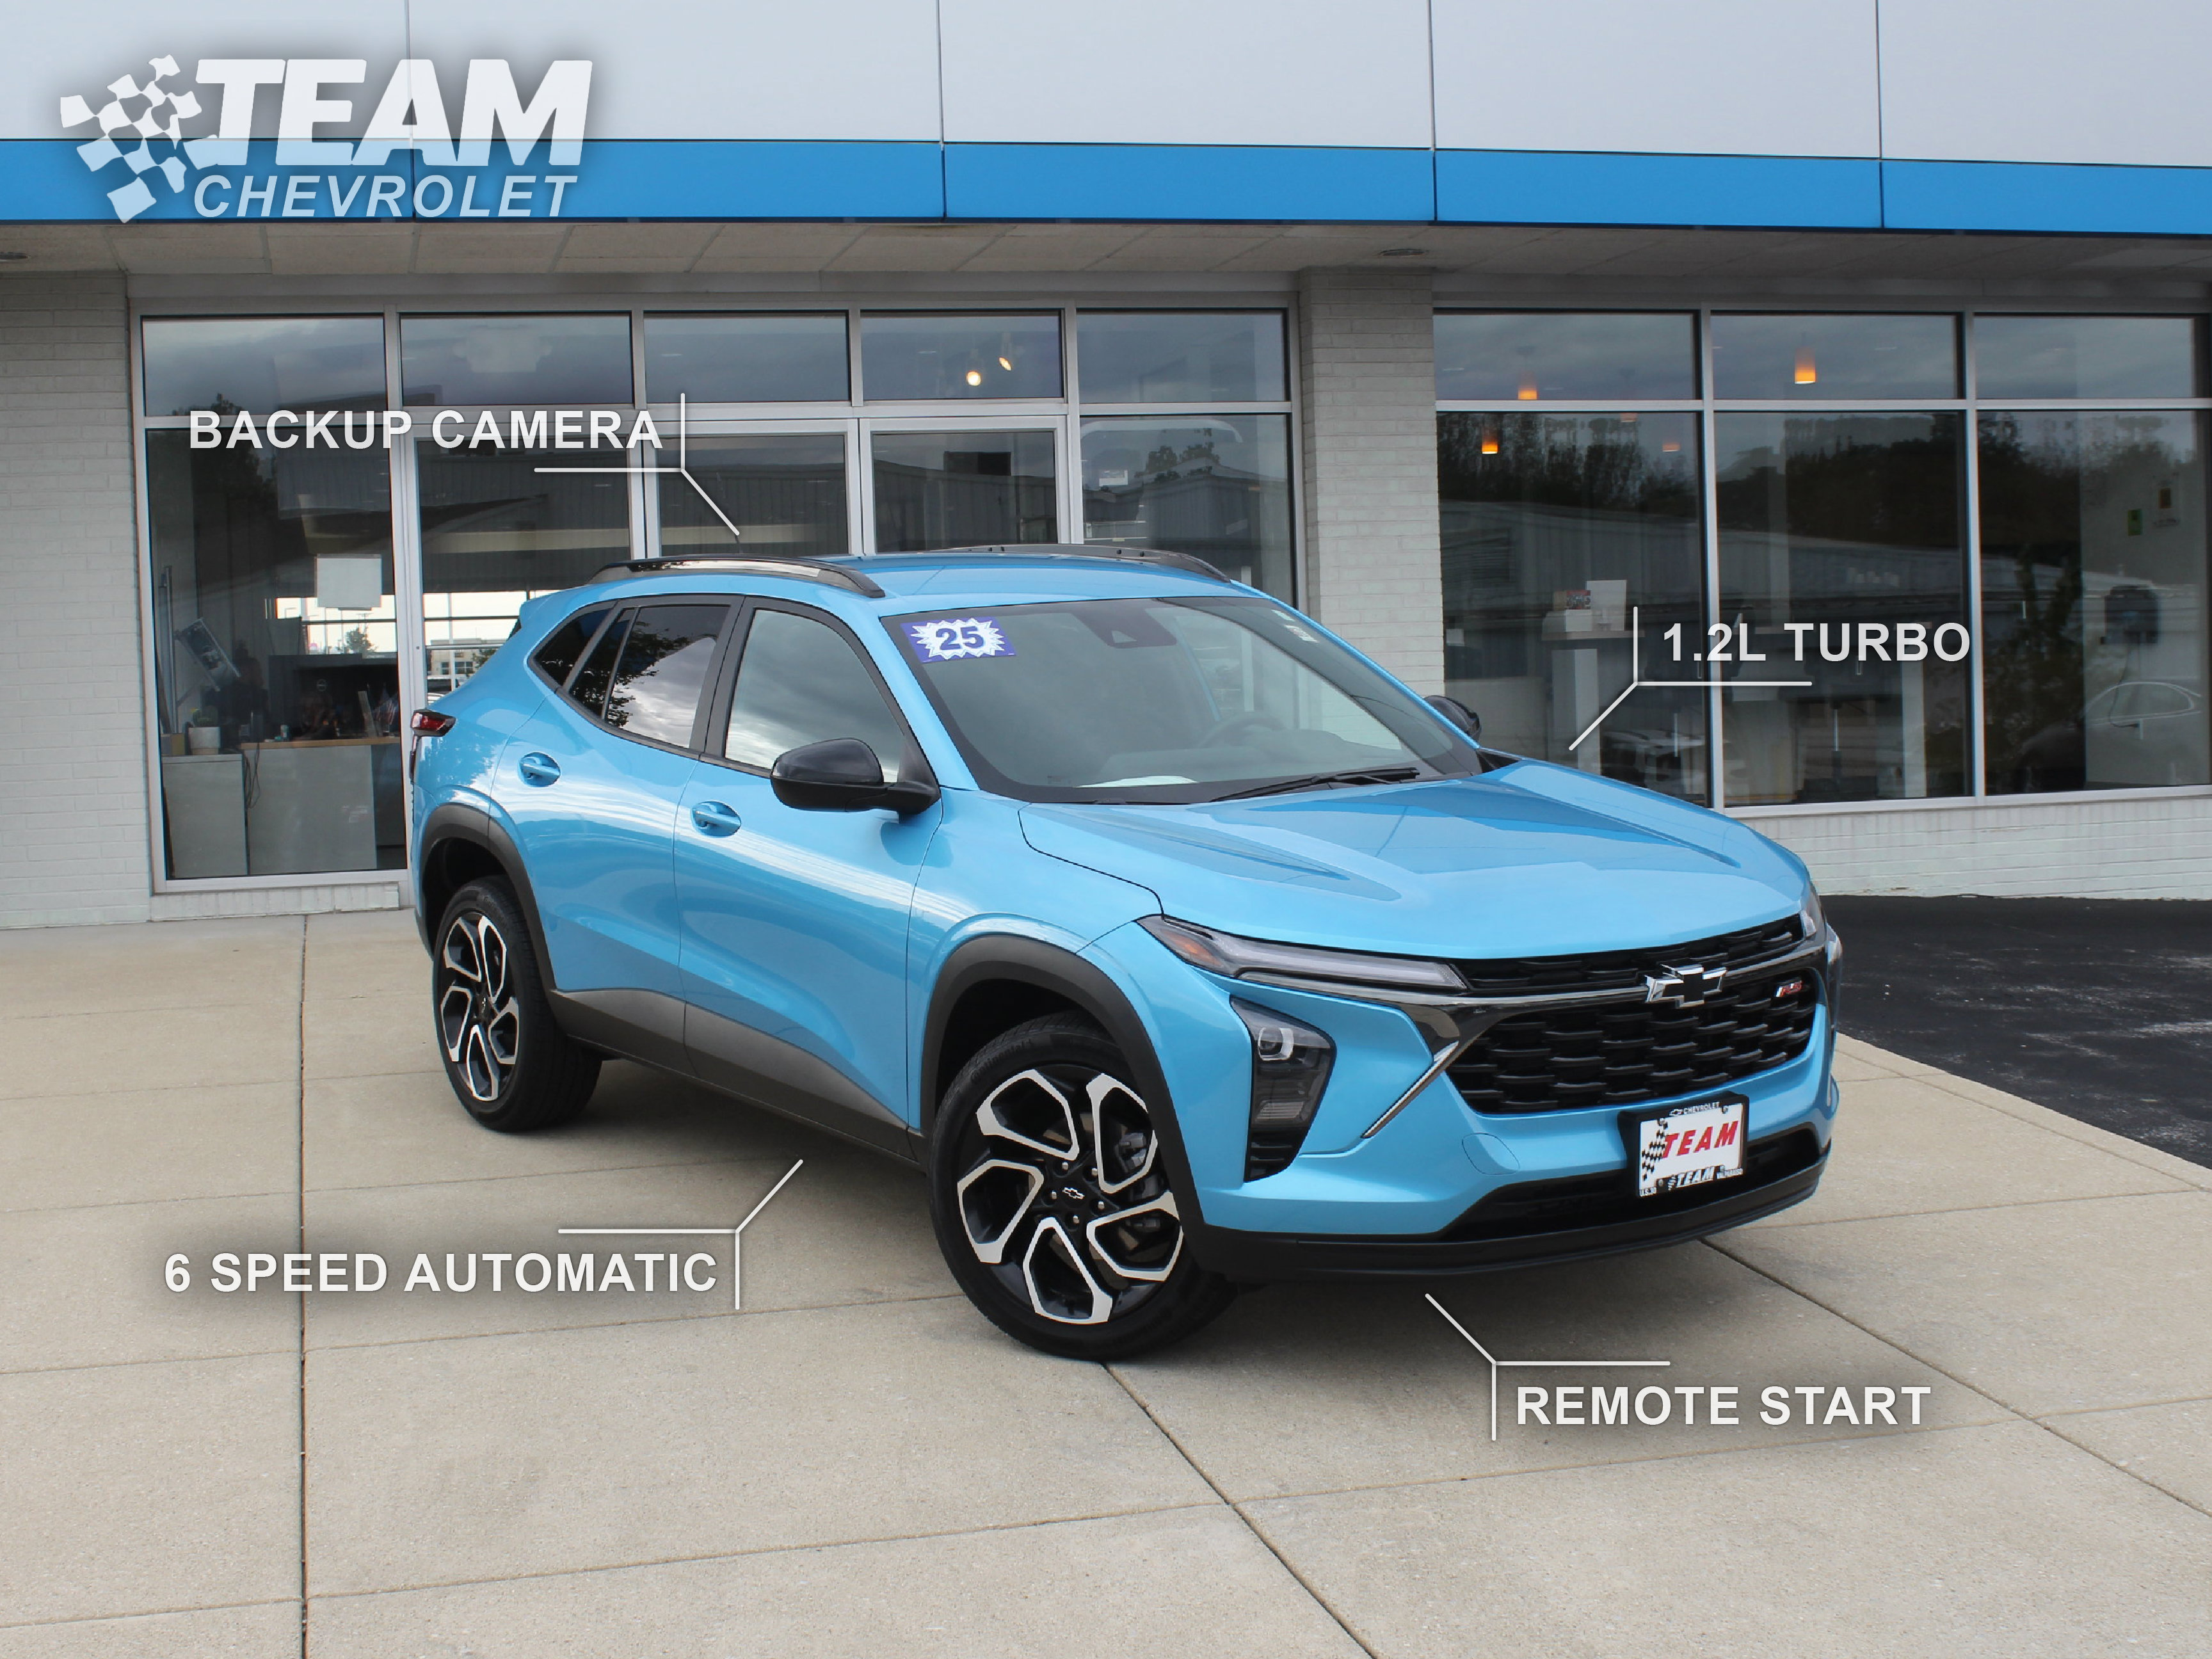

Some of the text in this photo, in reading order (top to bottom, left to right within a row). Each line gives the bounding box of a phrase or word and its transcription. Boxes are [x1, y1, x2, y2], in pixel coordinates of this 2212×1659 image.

[935, 625, 984, 650] 25
[1775, 980, 1803, 997] RS
[1683, 1102, 1720, 1114] CHEVROLET
[1662, 1120, 1739, 1159] TEAM
[1675, 1167, 1715, 1187] TEAM
